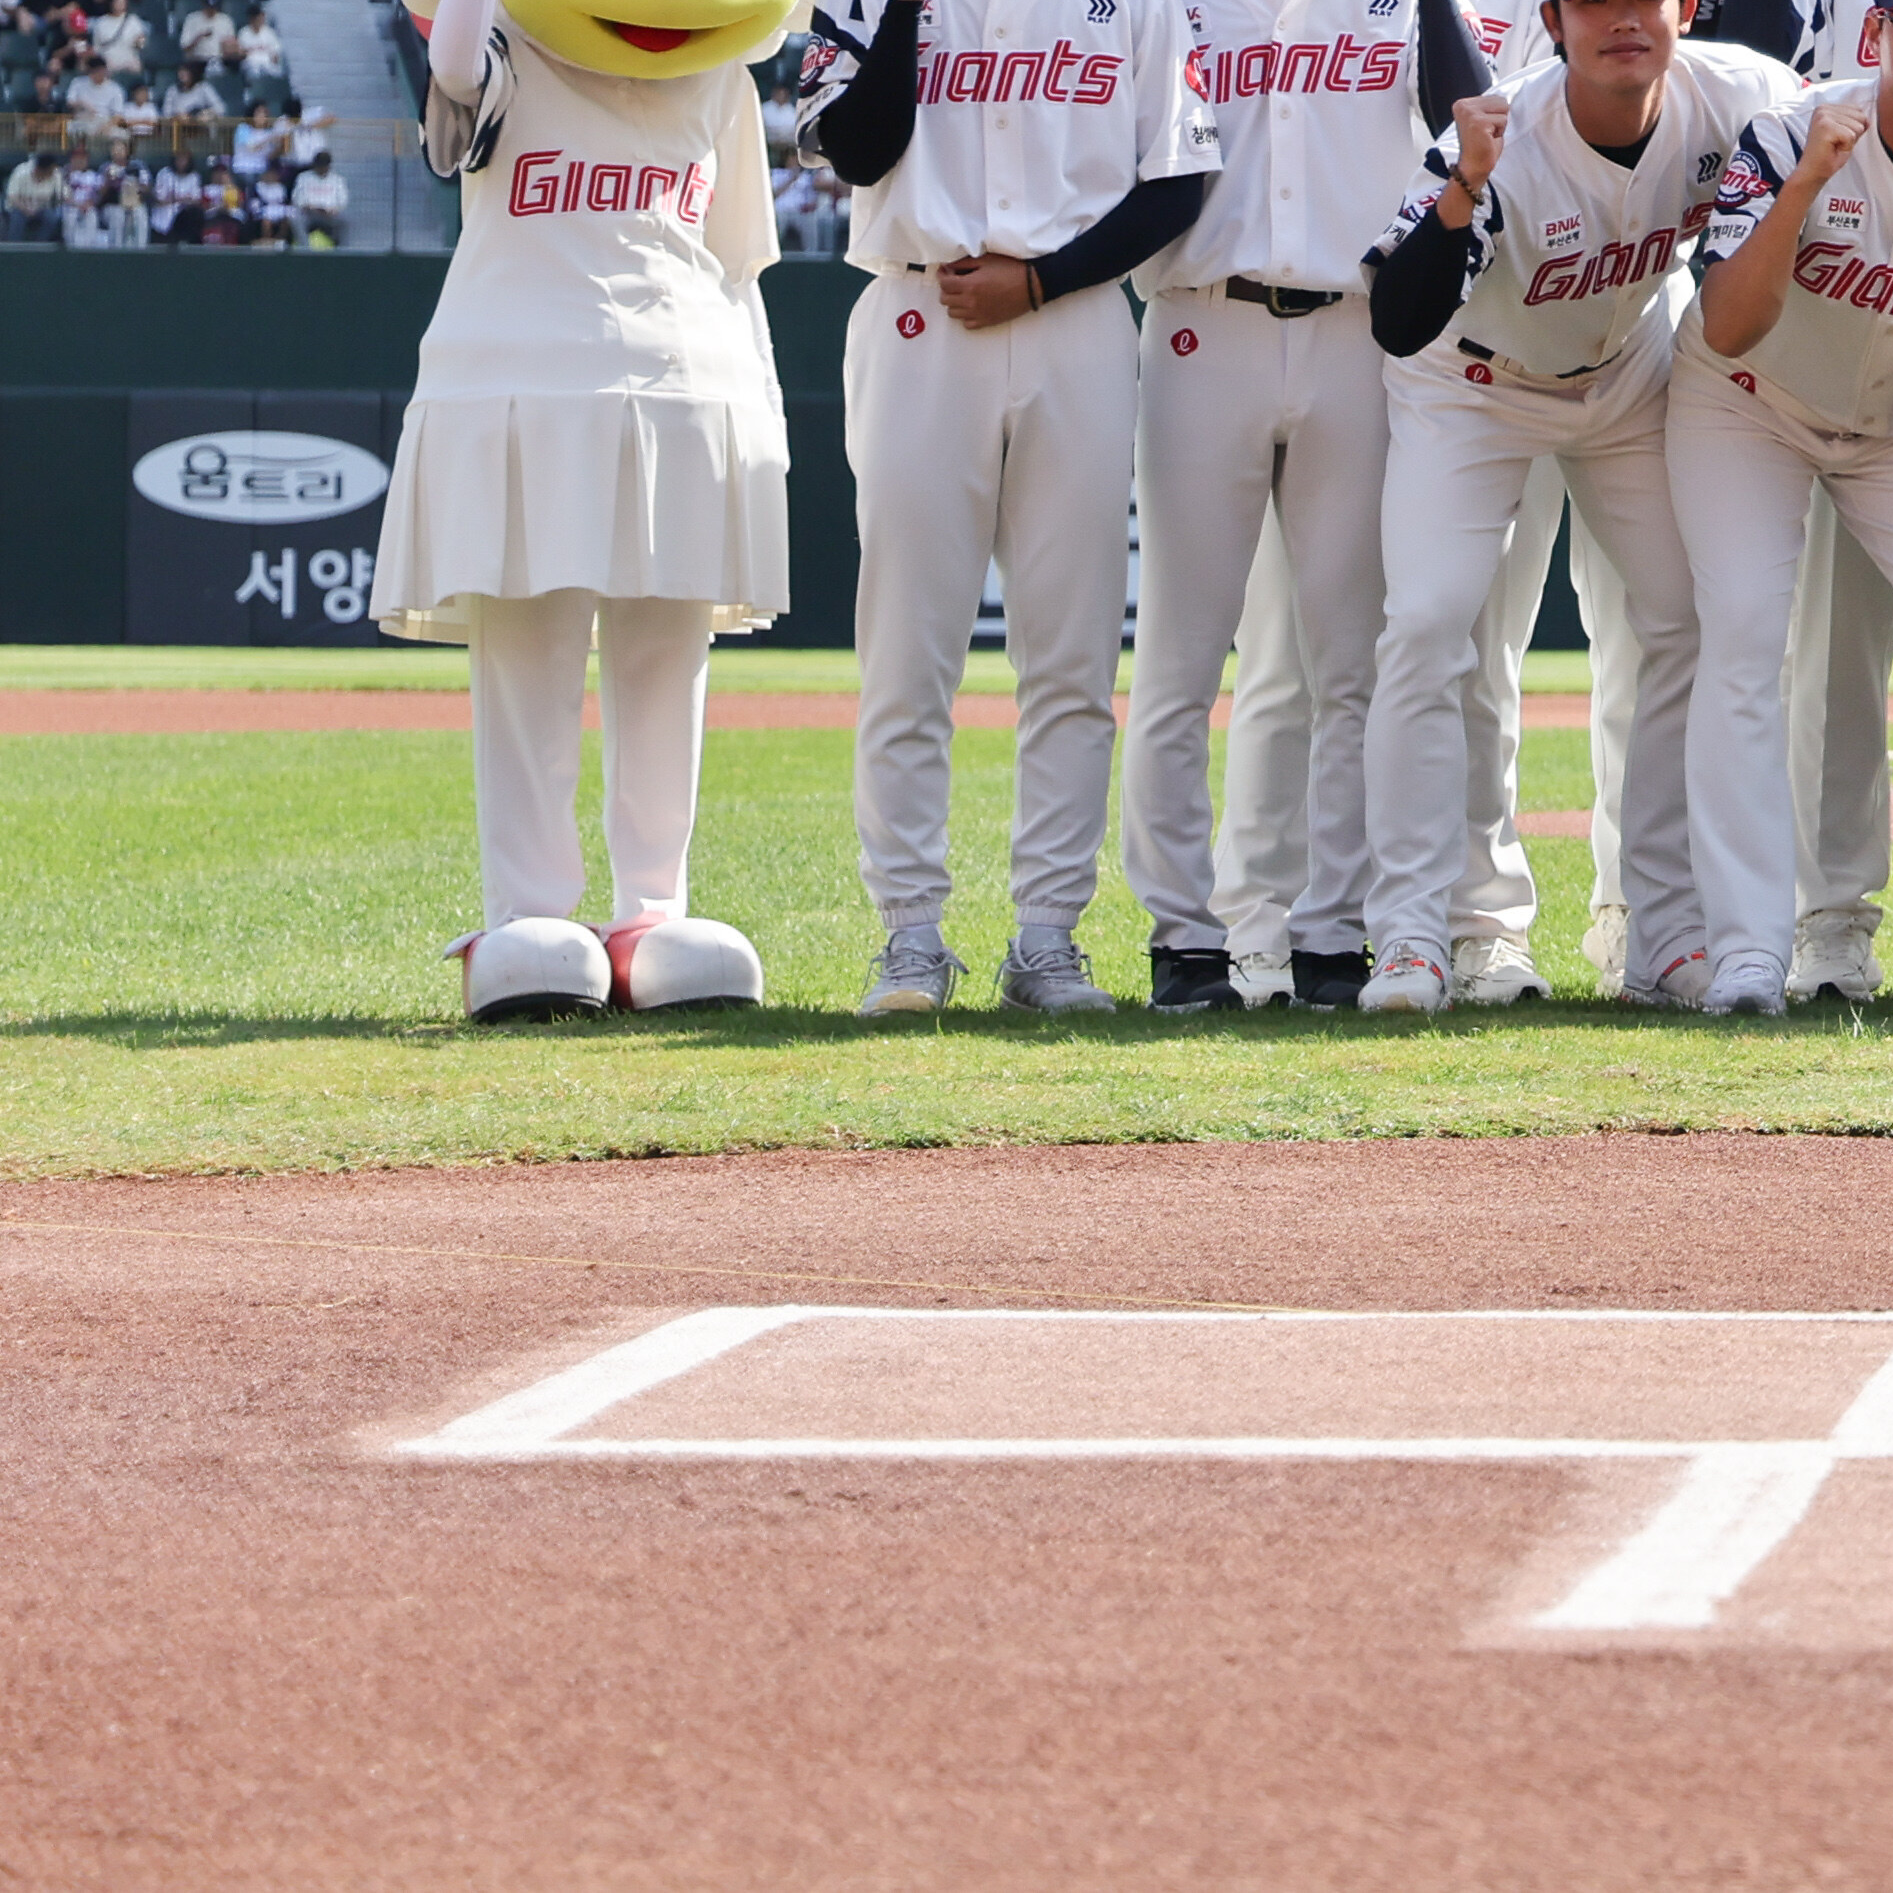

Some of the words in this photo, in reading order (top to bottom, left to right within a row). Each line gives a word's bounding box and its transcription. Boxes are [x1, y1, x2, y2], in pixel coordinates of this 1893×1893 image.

[508, 149, 714, 225] Giant
[1829, 197, 1865, 217] BNK
[1544, 215, 1582, 237] BNK
[1708, 224, 1749, 240] 케미칼
